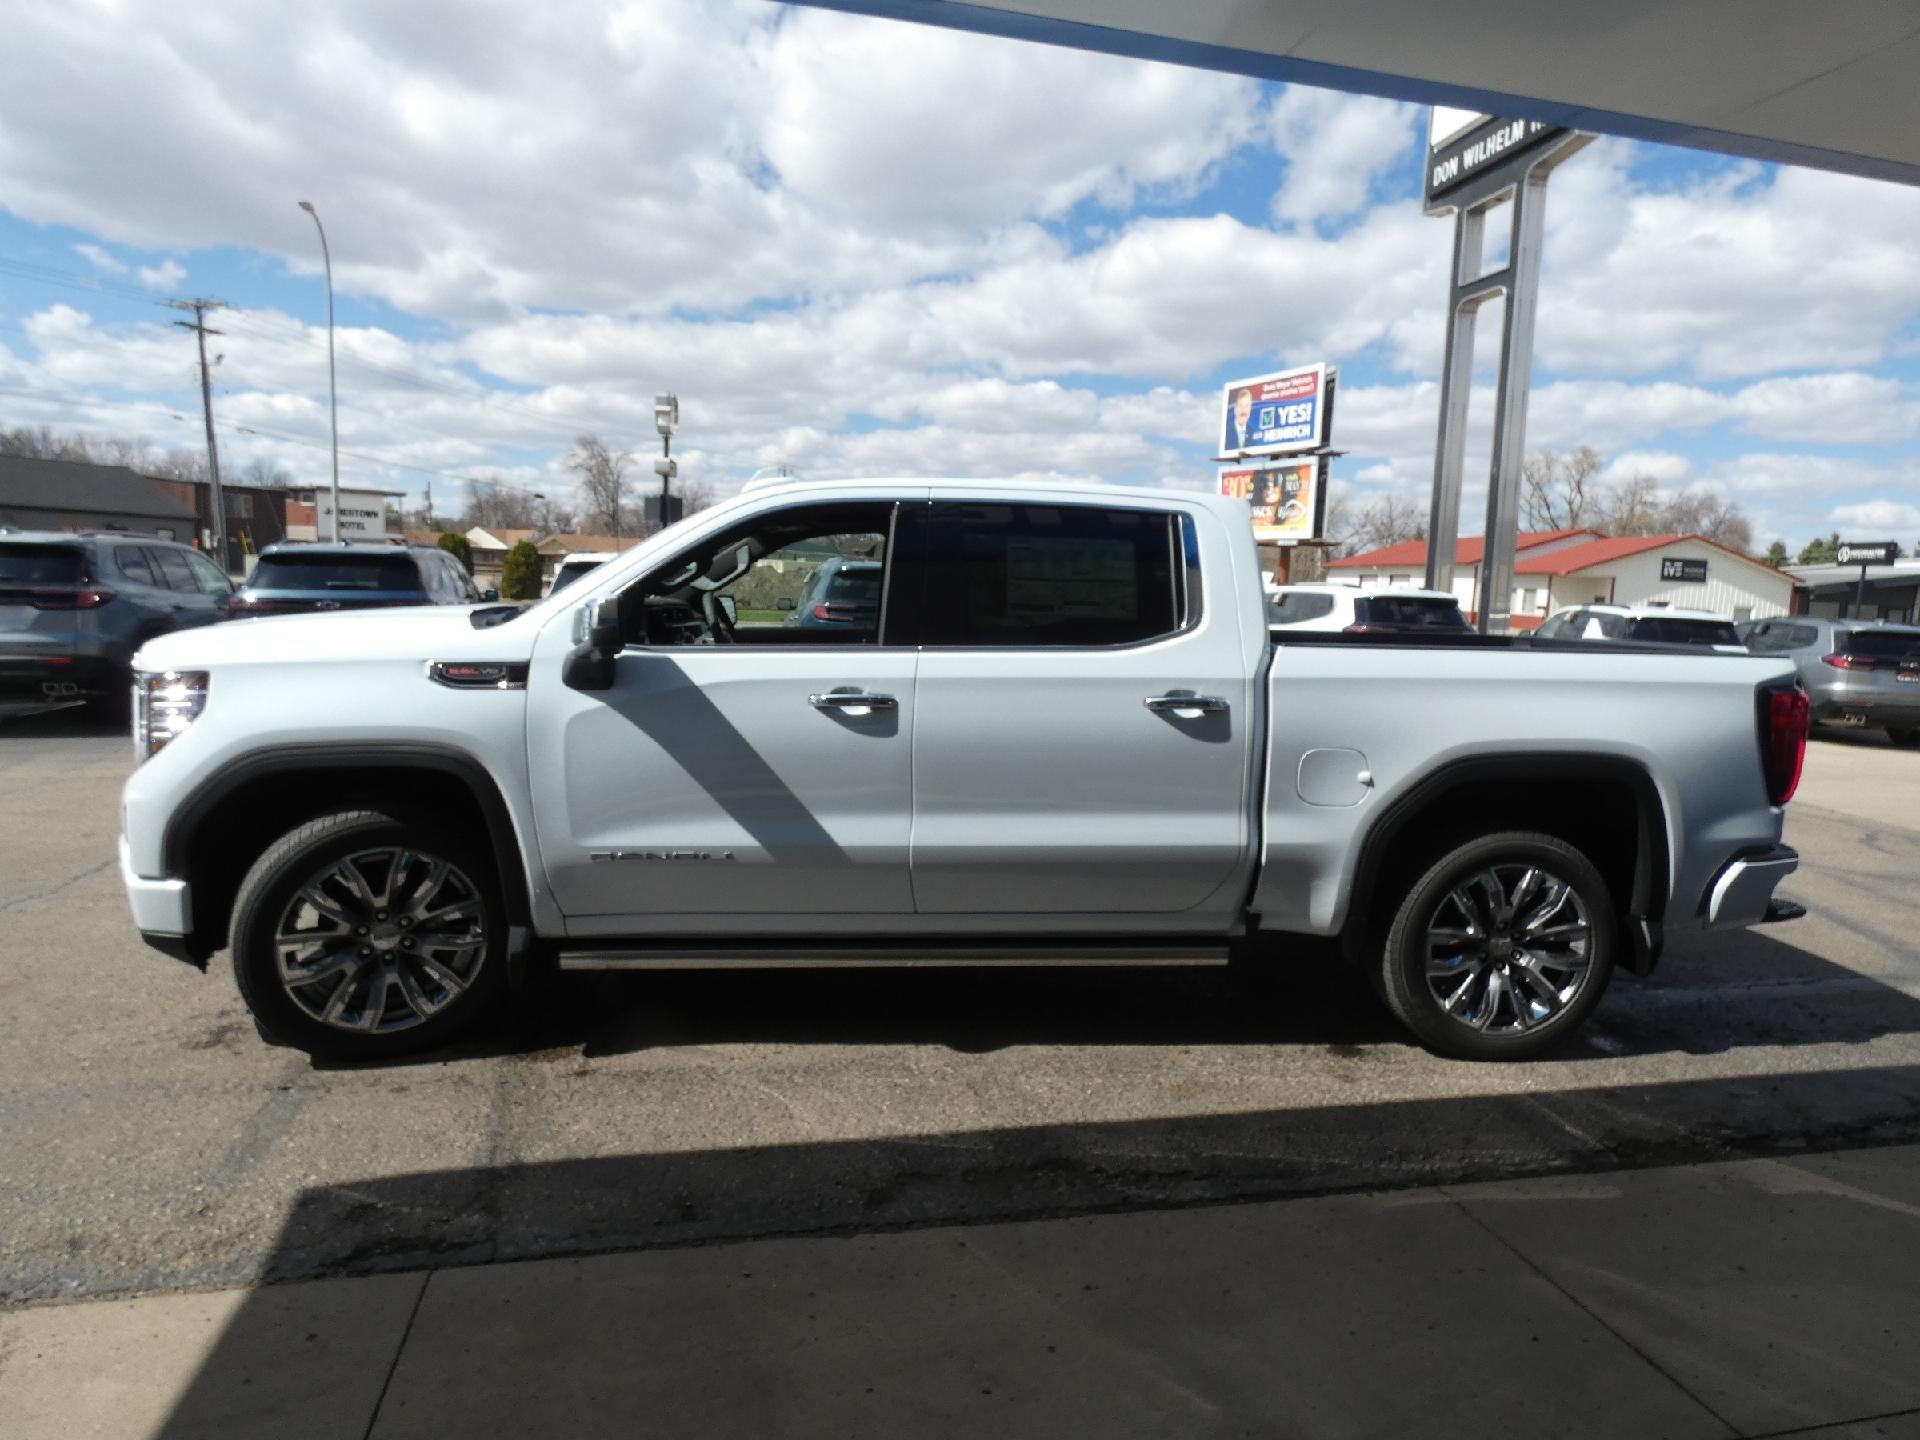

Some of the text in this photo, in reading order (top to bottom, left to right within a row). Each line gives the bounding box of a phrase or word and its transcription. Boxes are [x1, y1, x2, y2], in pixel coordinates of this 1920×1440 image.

[1433, 118, 1525, 187] DON WILHELM
[1277, 402, 1312, 425] YES!
